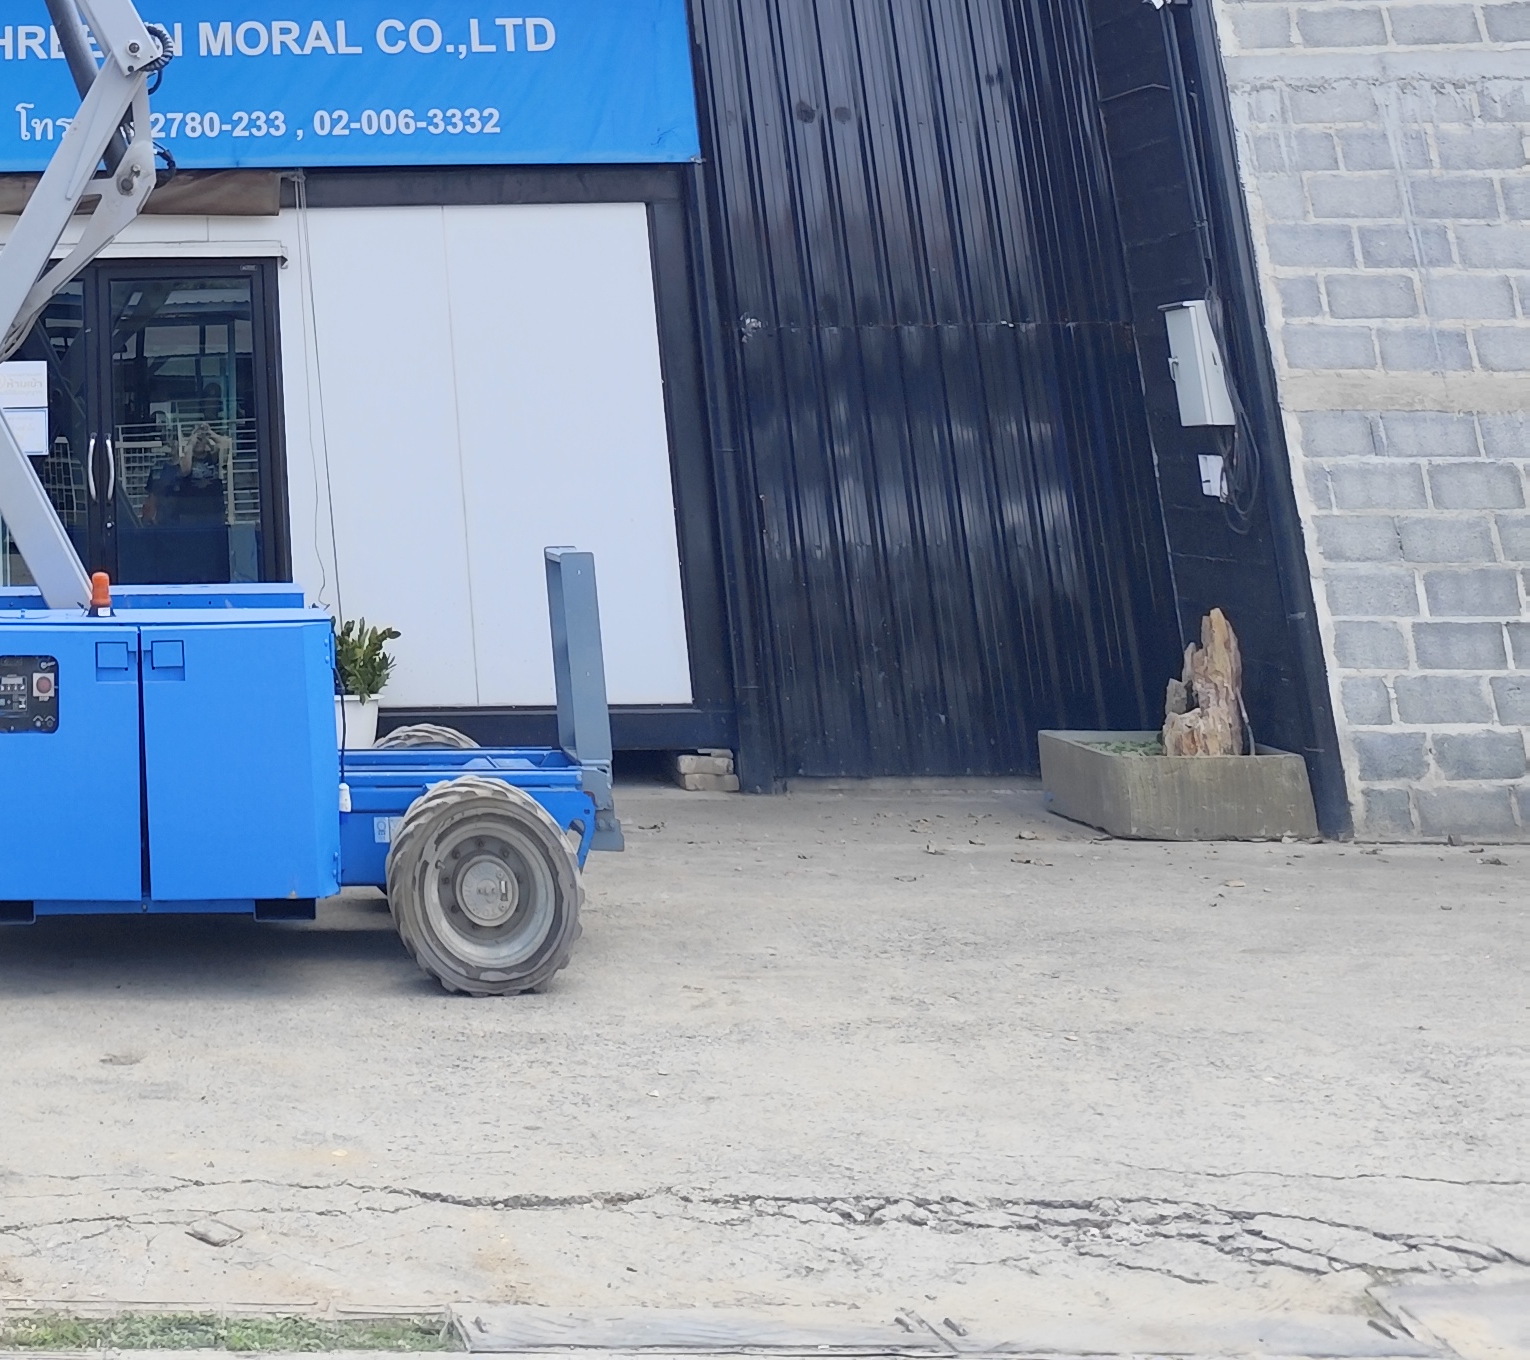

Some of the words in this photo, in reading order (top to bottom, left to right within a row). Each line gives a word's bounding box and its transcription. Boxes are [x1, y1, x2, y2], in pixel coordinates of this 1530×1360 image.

[198, 19, 363, 57] MORAL
[375, 17, 556, 60] CO.,LTD
[313, 108, 501, 136] 02-006-3332
